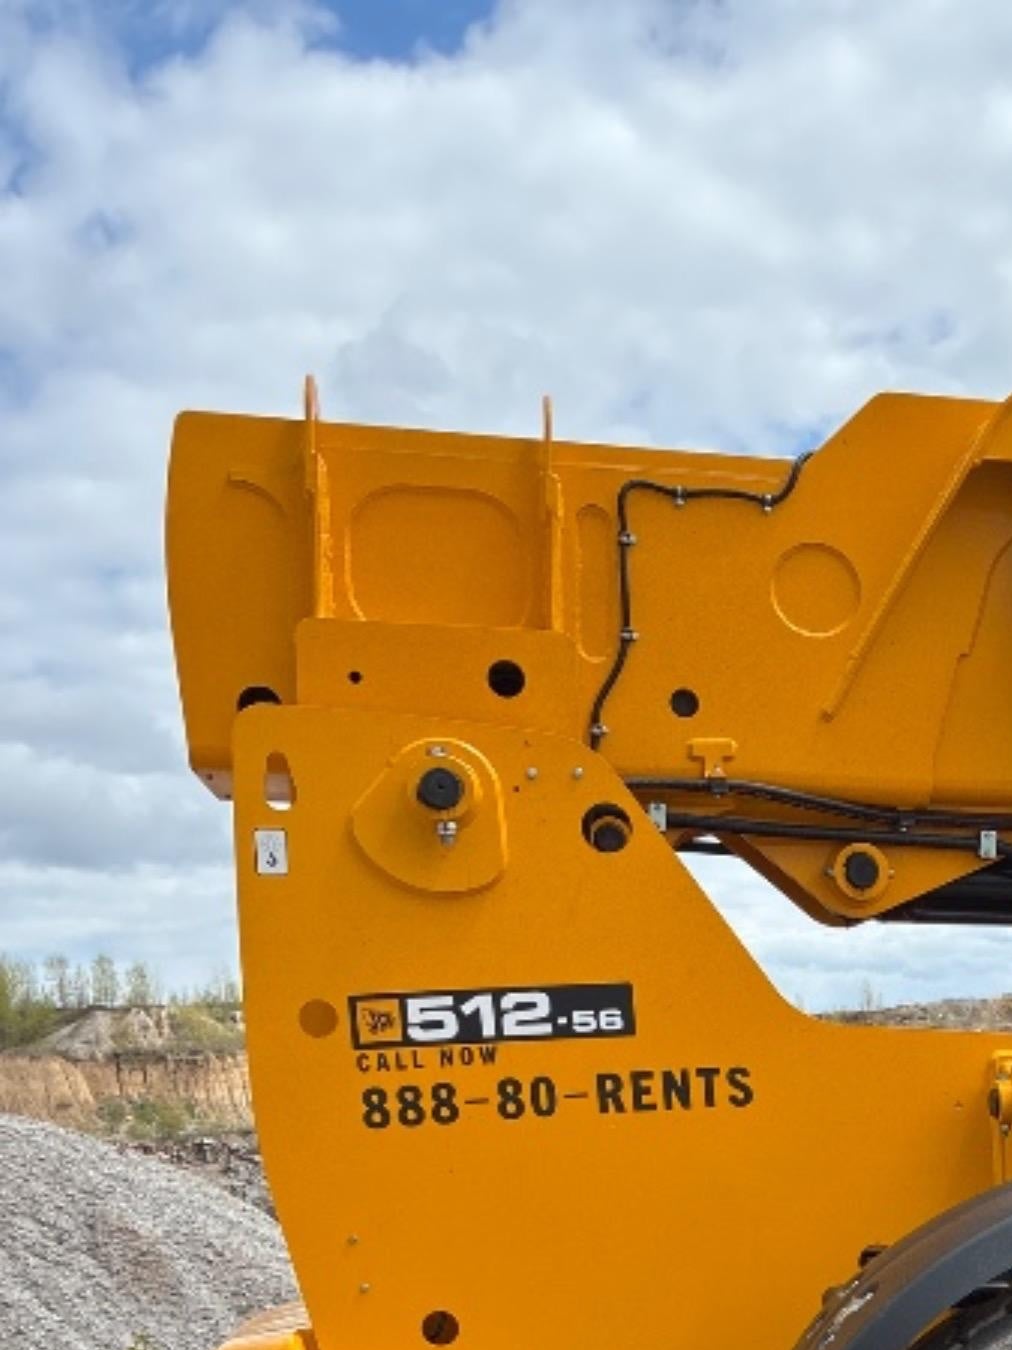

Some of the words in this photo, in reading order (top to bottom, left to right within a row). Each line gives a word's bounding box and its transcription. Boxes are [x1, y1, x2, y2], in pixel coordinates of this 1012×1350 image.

[356, 1052, 425, 1073] CALL
[439, 1046, 498, 1068] NOW
[361, 1067, 754, 1129] 888-80-RENTS
